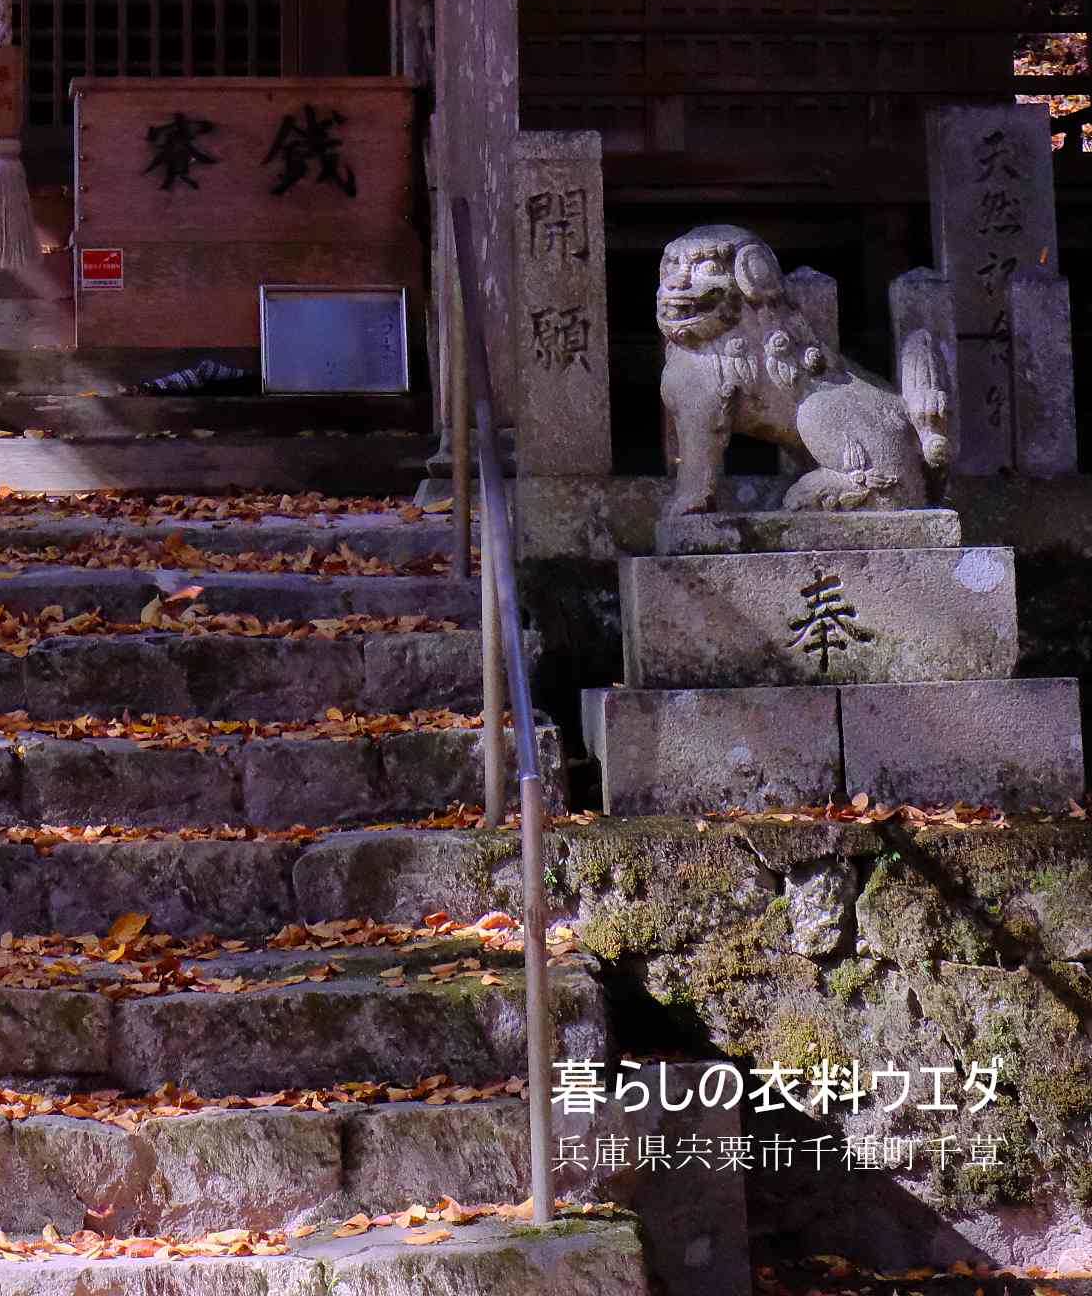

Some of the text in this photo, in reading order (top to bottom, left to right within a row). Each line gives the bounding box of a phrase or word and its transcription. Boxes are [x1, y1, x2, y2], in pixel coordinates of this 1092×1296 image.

[975, 130, 1023, 428] 天然記
[784, 568, 876, 673] 奉
